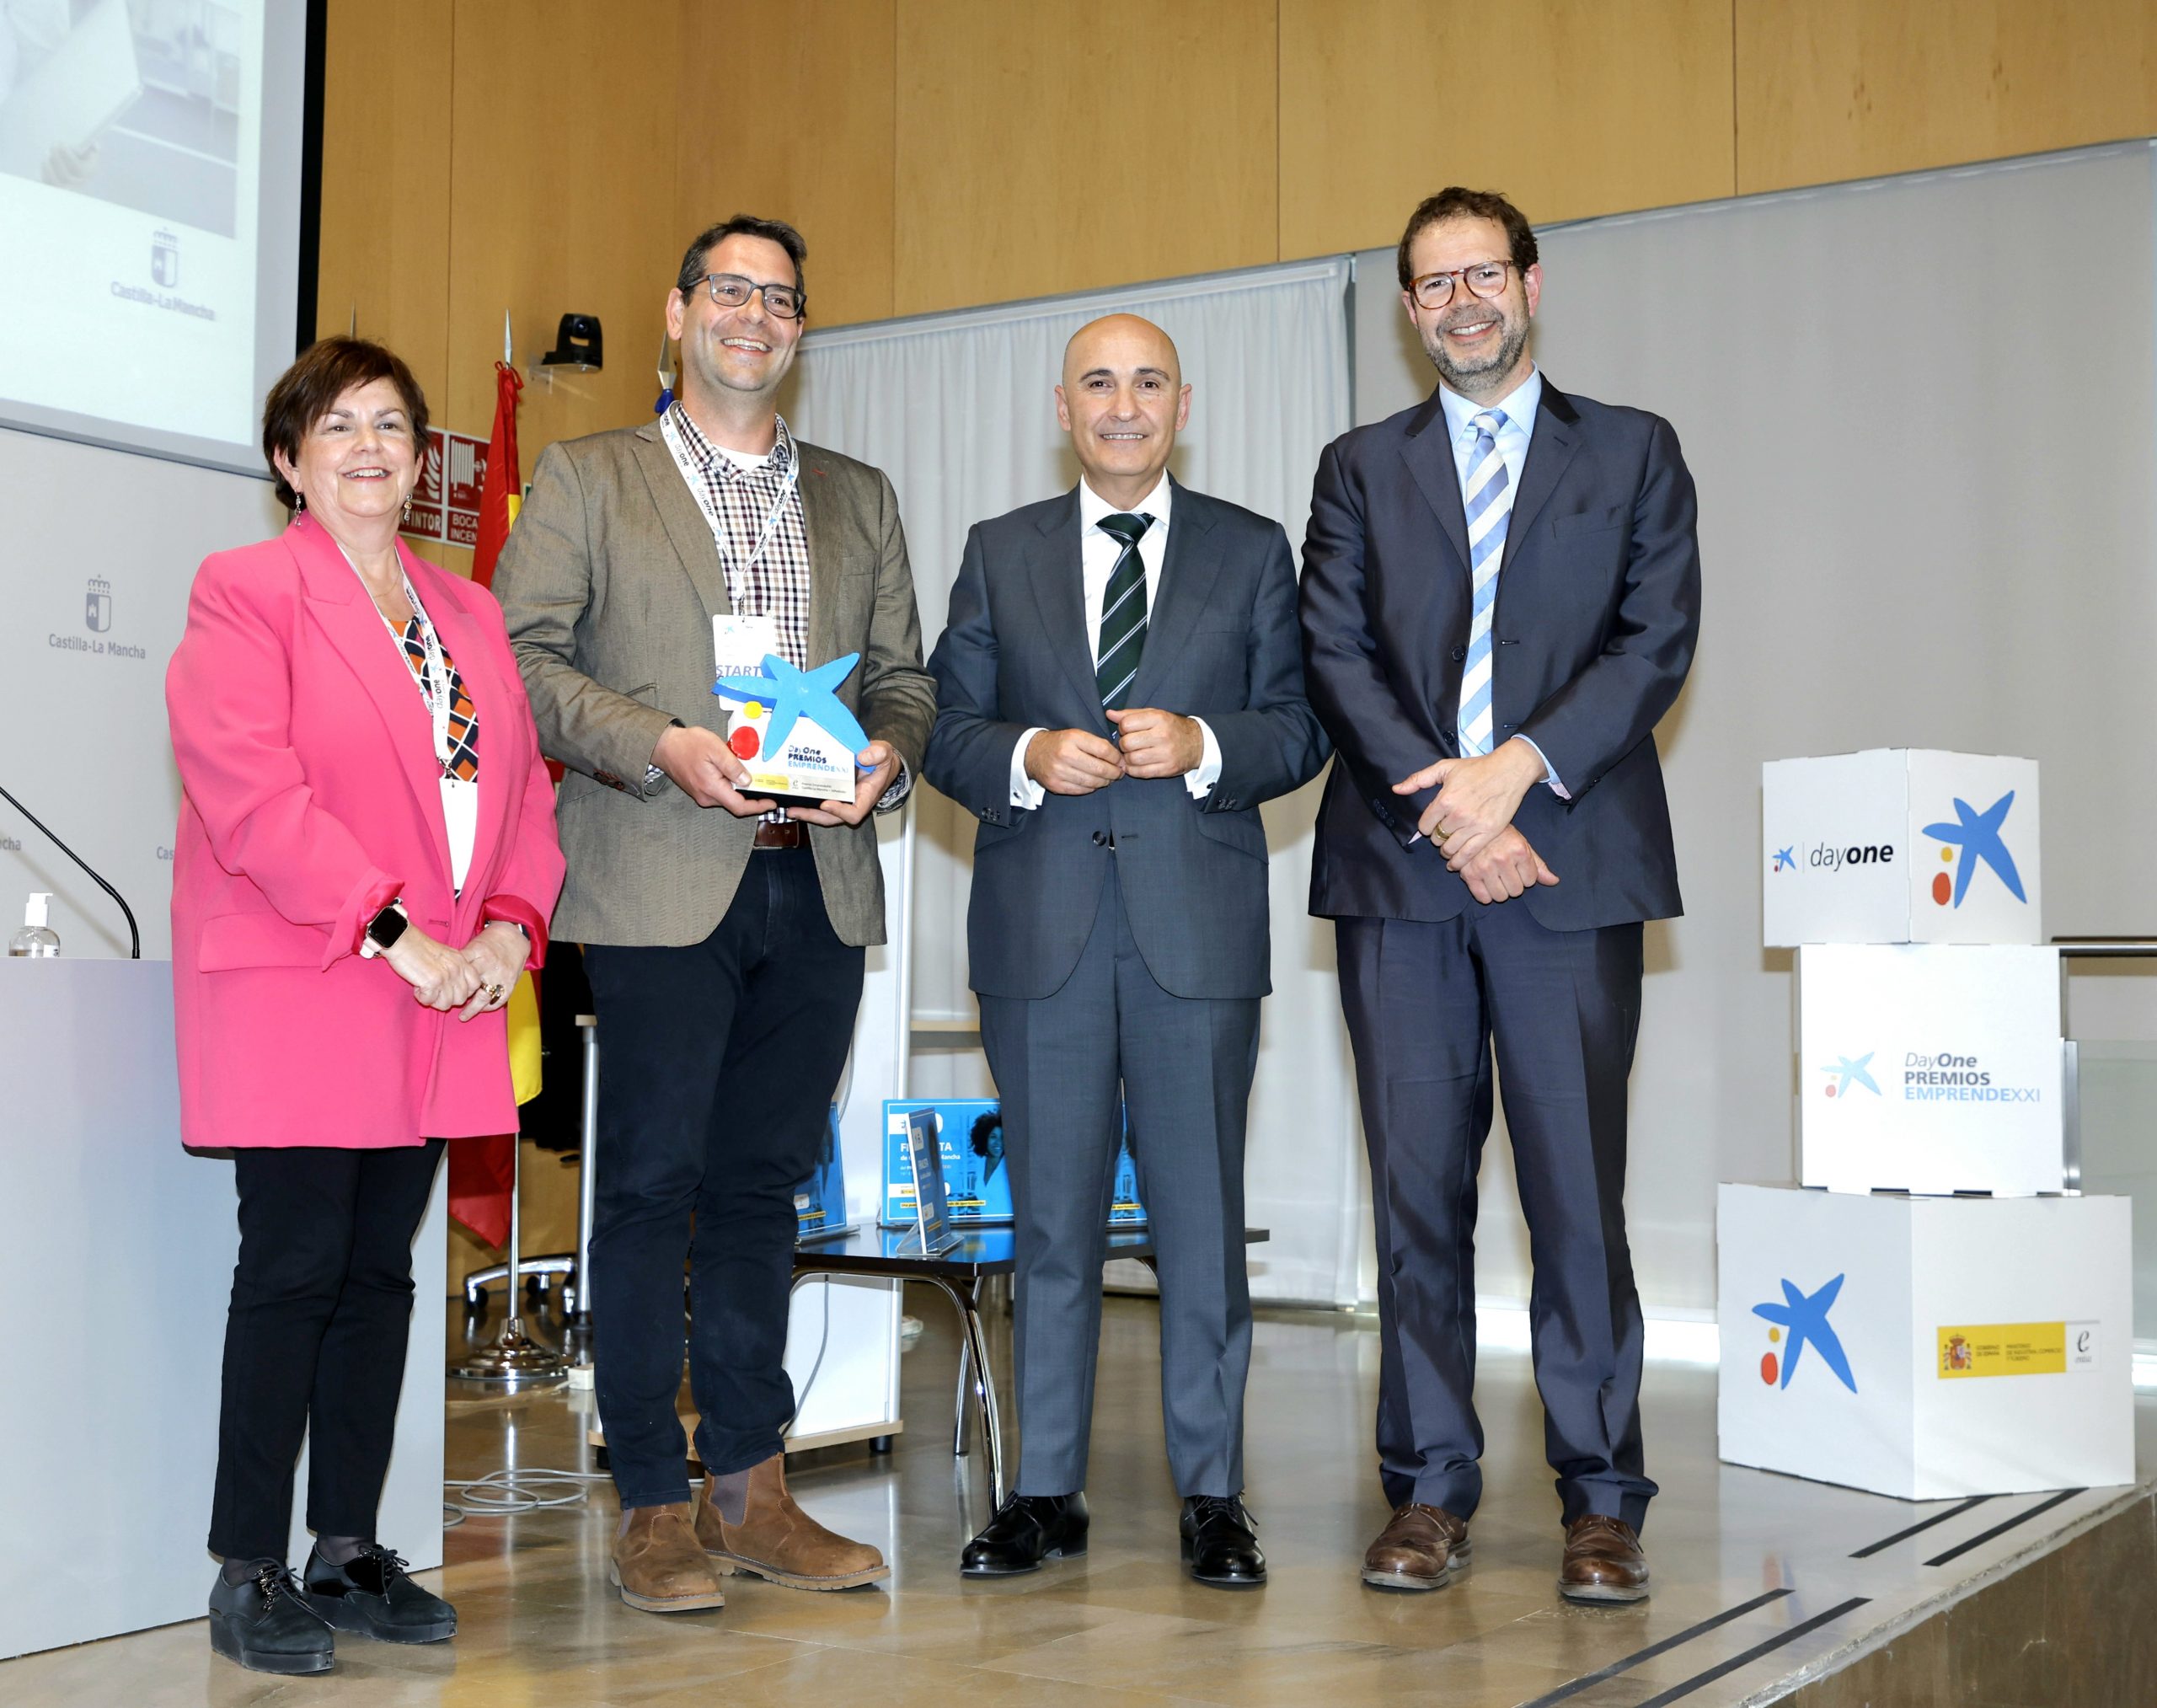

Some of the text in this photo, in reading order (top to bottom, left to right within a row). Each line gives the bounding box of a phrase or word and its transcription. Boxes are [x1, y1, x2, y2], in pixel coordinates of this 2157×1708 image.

[452, 513, 479, 529] BOCA
[49, 634, 146, 659] Castilla-La Mancha
[426, 634, 435, 660] dayone
[716, 665, 761, 677] START
[434, 679, 443, 709] dayone
[789, 753, 827, 763] PREMIOS
[1811, 842, 1893, 871] dayone
[1904, 1052, 1977, 1070] DayOne
[1904, 1071, 1990, 1085] PREMIOS
[1904, 1087, 2040, 1102] EMPRENDEXXI
